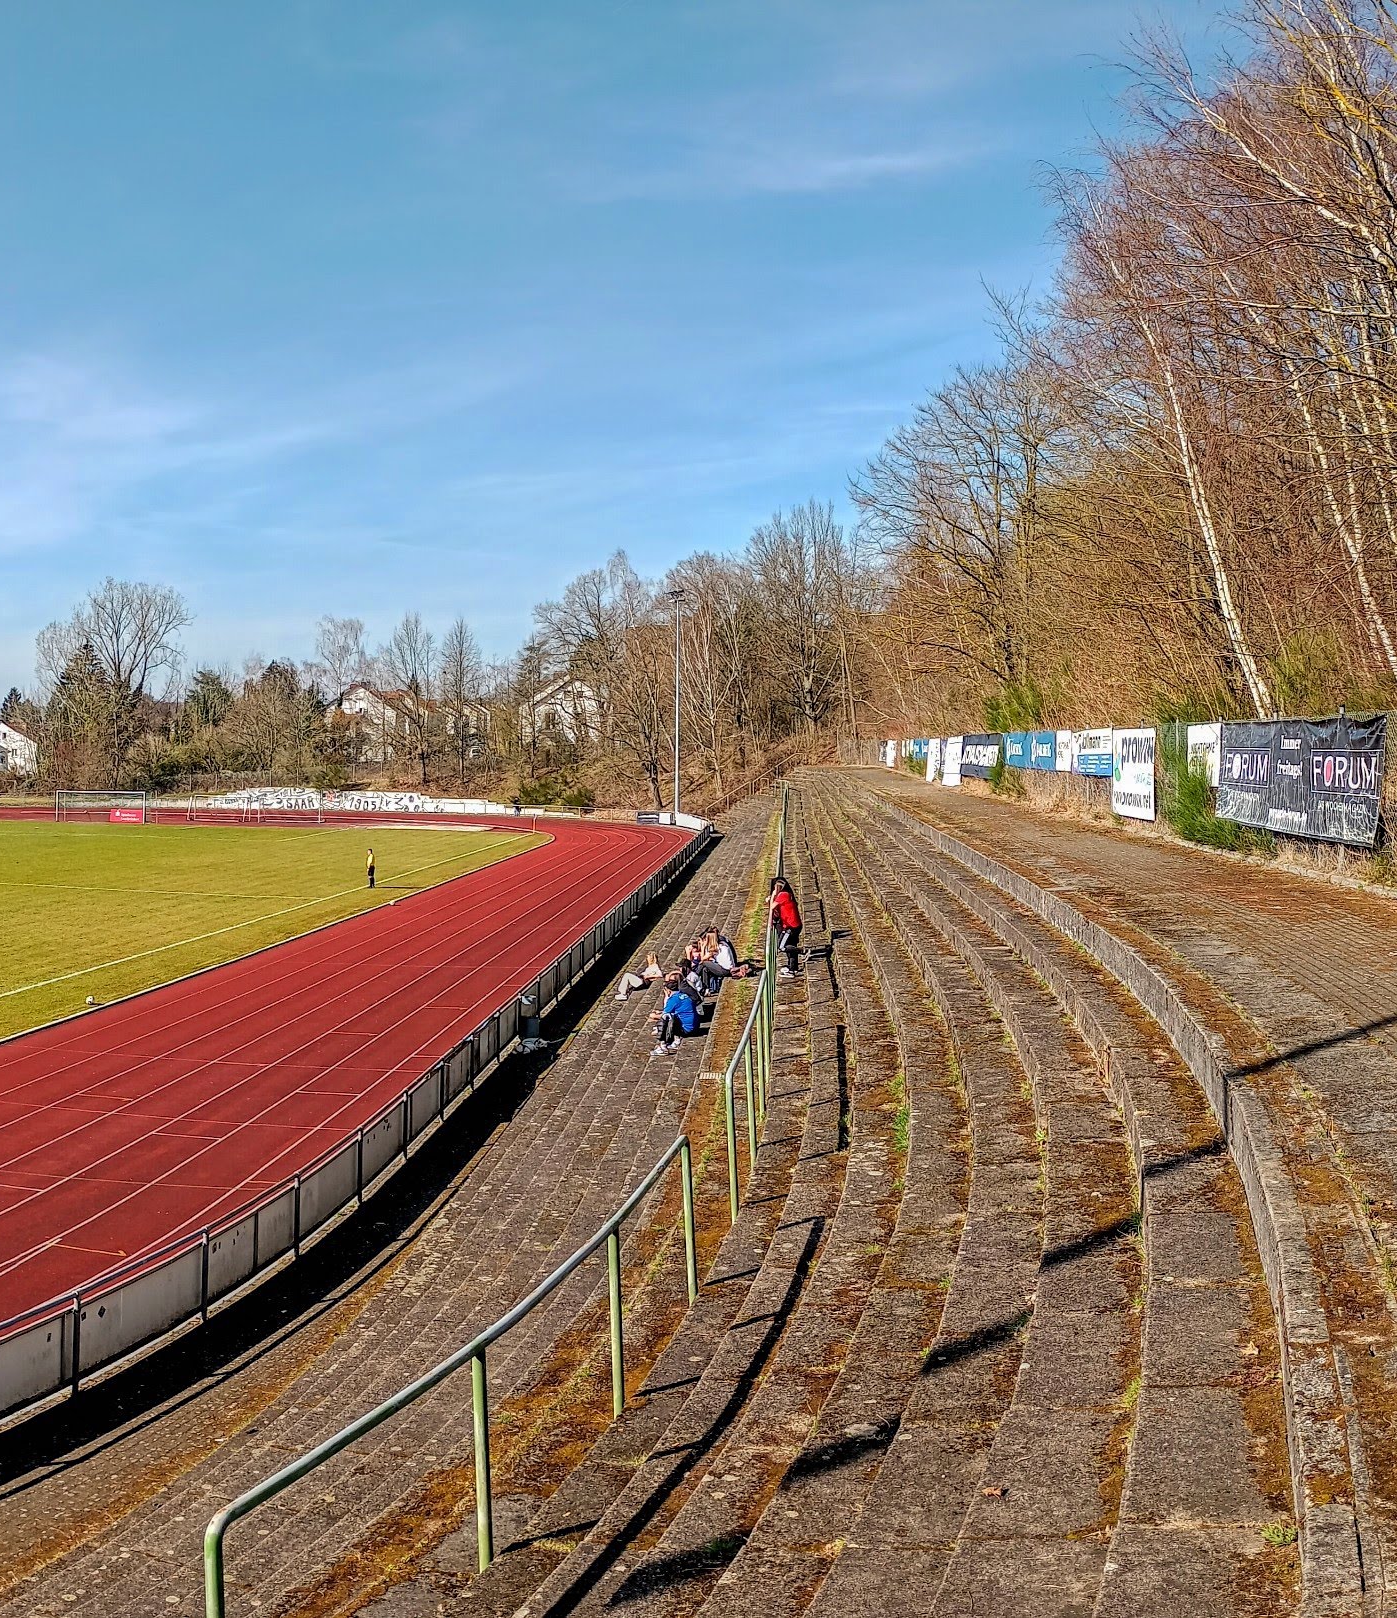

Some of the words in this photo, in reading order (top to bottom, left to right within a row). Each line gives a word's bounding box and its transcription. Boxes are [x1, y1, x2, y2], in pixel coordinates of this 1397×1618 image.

[1280, 735, 1301, 750] Immer
[1225, 753, 1268, 782] FORUM
[1312, 755, 1376, 790] FORUM
